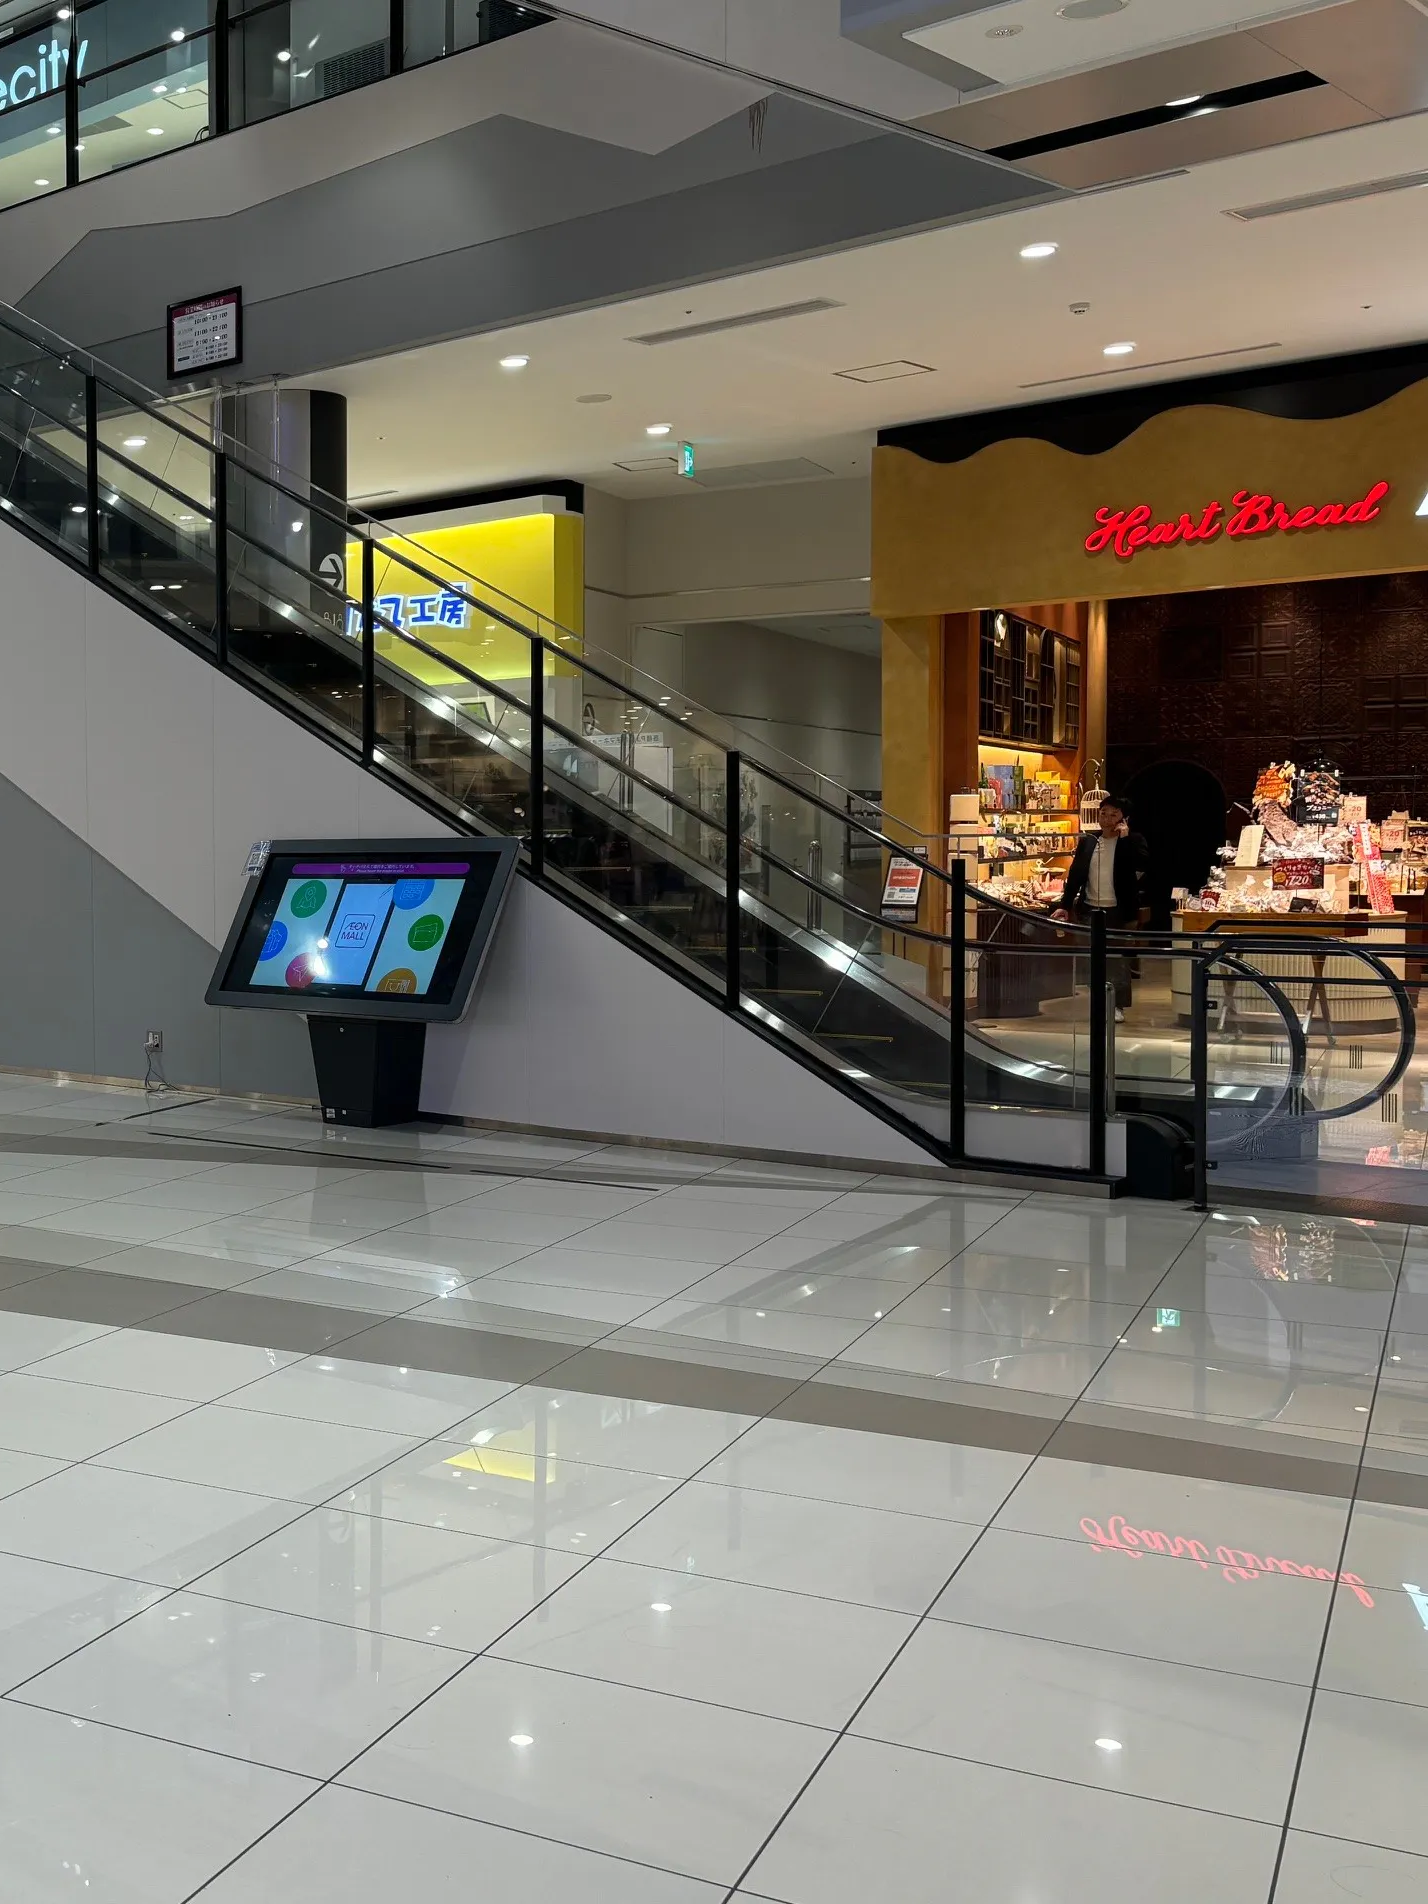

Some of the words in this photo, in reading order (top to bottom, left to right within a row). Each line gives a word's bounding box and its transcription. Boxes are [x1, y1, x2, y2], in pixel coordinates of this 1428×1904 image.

[1084, 500, 1224, 557] Heart
[1225, 480, 1390, 538] Bread
[340, 931, 364, 941] MALL
